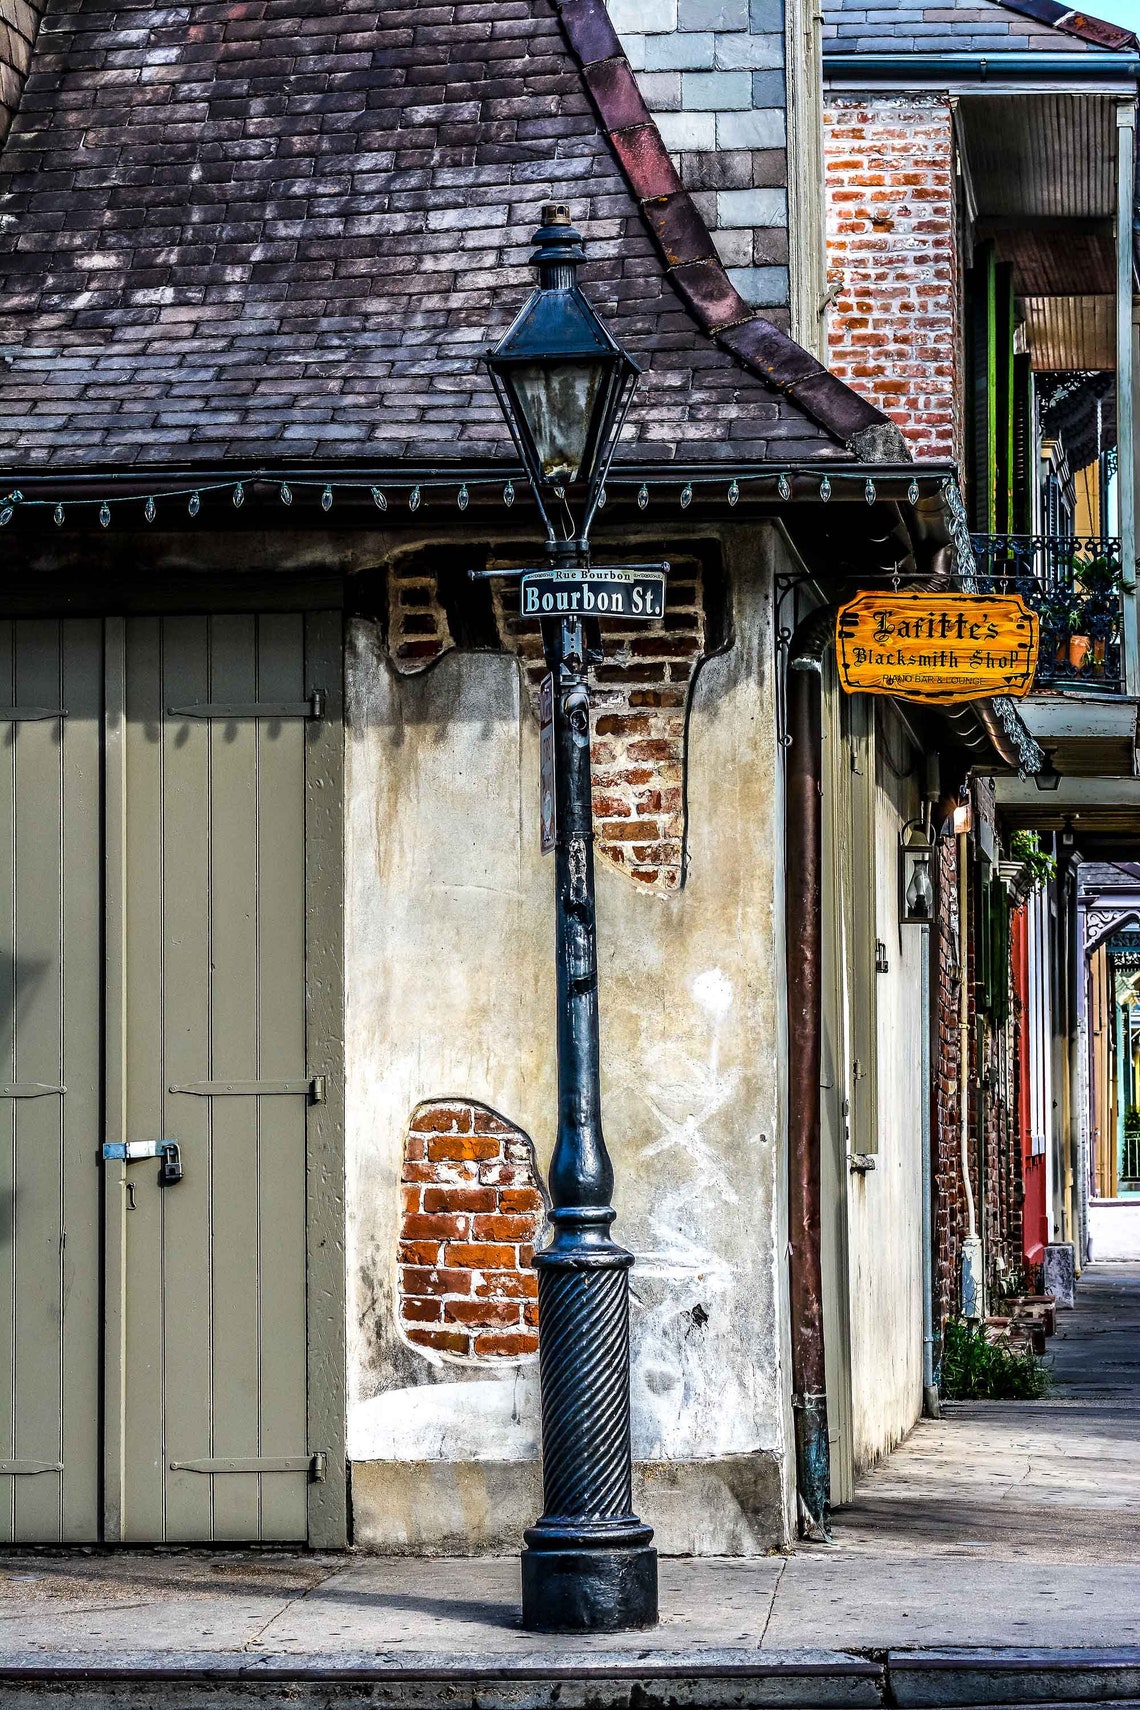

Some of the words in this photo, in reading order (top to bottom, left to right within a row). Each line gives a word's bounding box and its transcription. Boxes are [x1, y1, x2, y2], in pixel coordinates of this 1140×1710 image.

[555, 570, 577, 579] Rue
[581, 570, 631, 581] Bourbon
[525, 583, 624, 612] Bourbon
[631, 586, 661, 615] St.
[872, 609, 999, 642] Lafitte's
[852, 647, 958, 669] Blacksmith
[969, 649, 1019, 670] Shop
[882, 674, 912, 684] PIANO
[914, 675, 935, 684] BAR
[936, 675, 944, 684] &
[945, 676, 986, 685] LOUNGE
